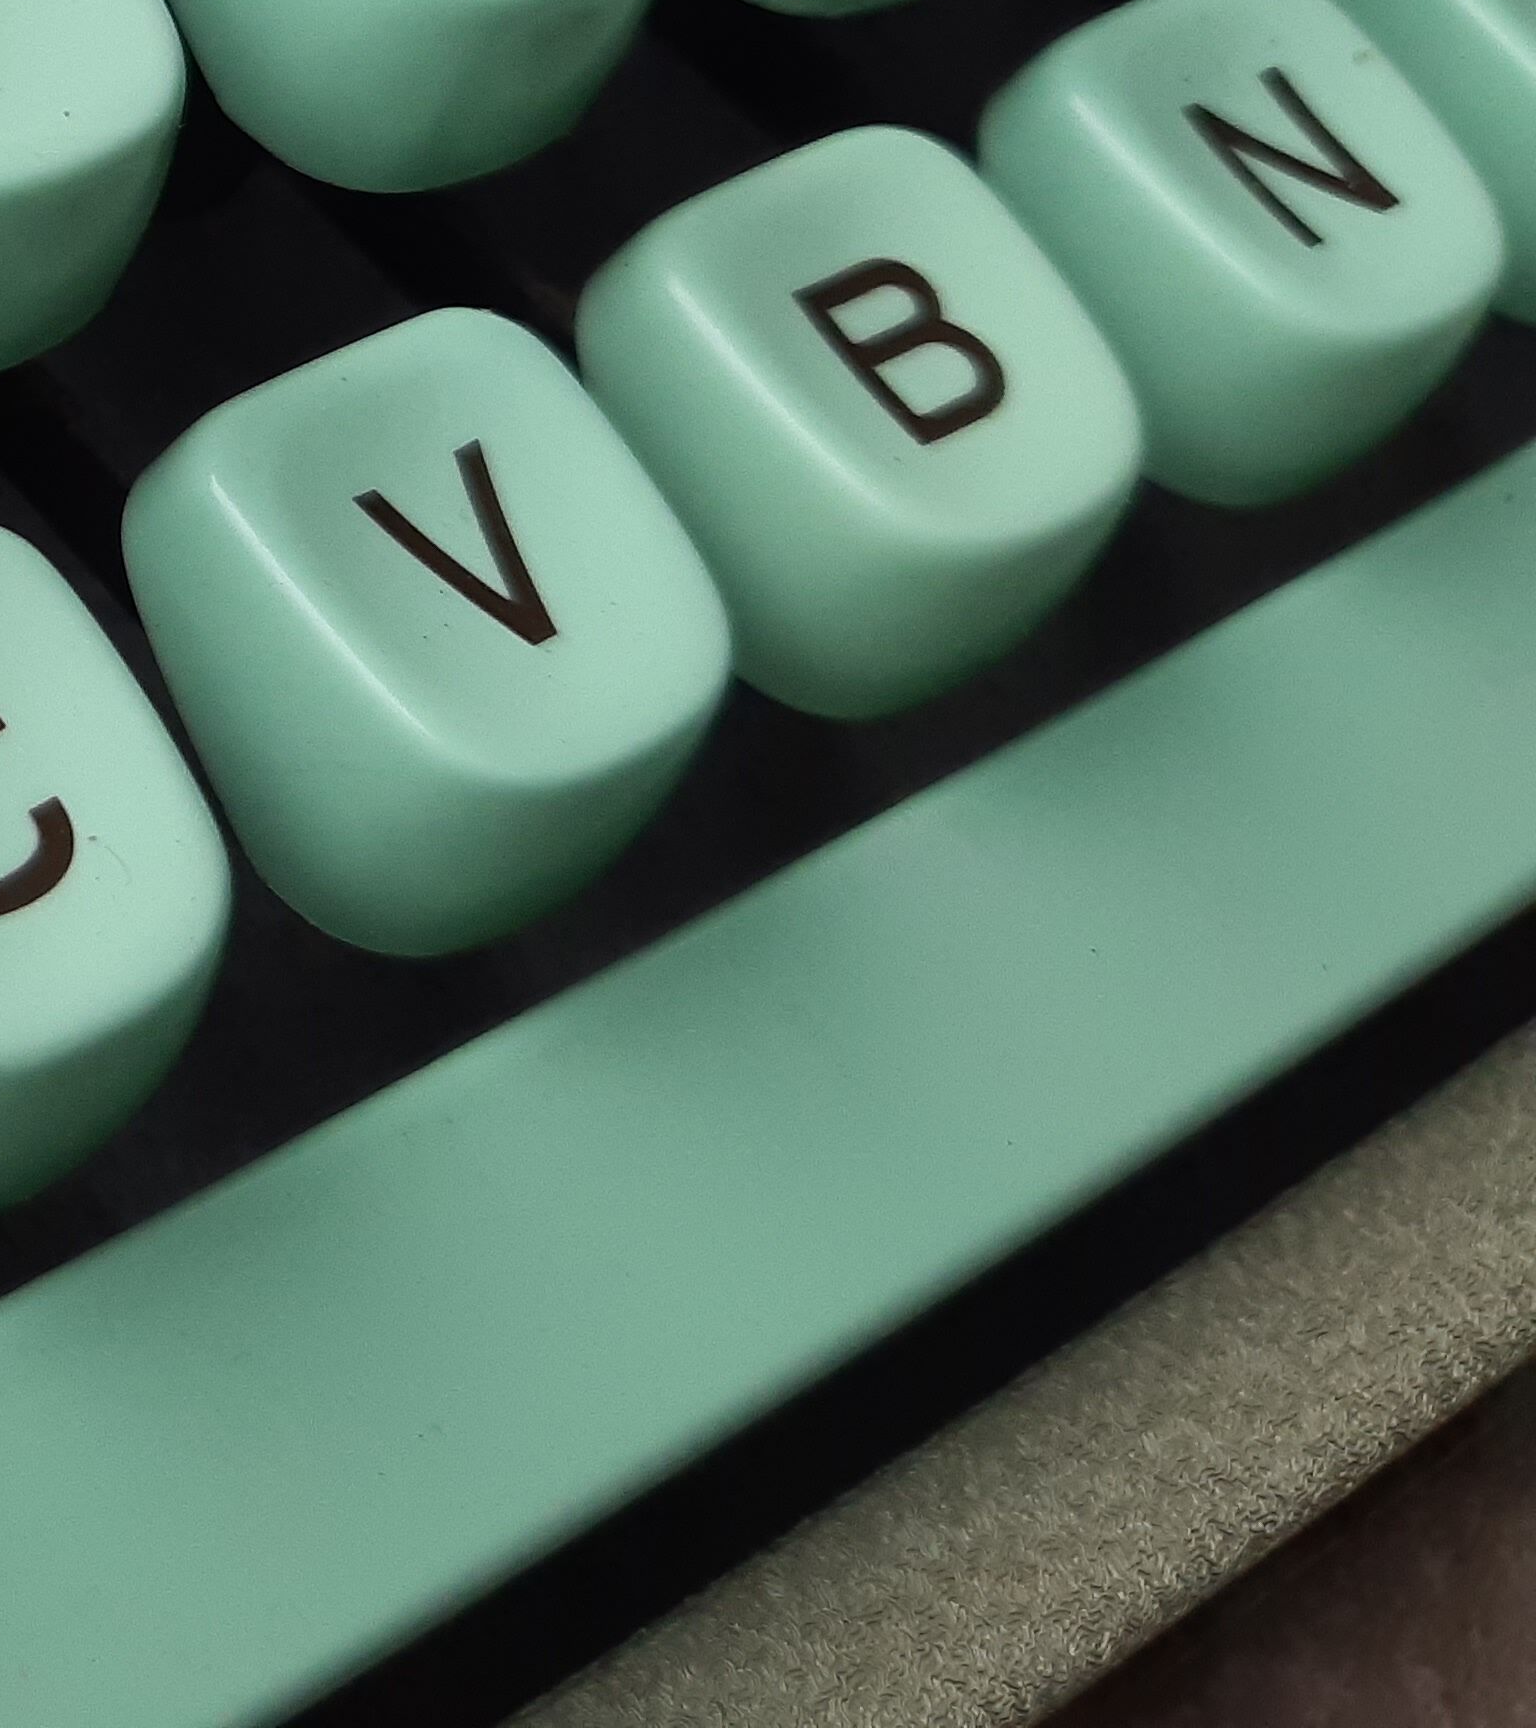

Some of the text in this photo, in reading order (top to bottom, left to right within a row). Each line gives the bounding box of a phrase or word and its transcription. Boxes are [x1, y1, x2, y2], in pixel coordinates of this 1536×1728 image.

[1184, 68, 1399, 247] N
[792, 259, 1005, 445] B
[353, 440, 557, 645] V
